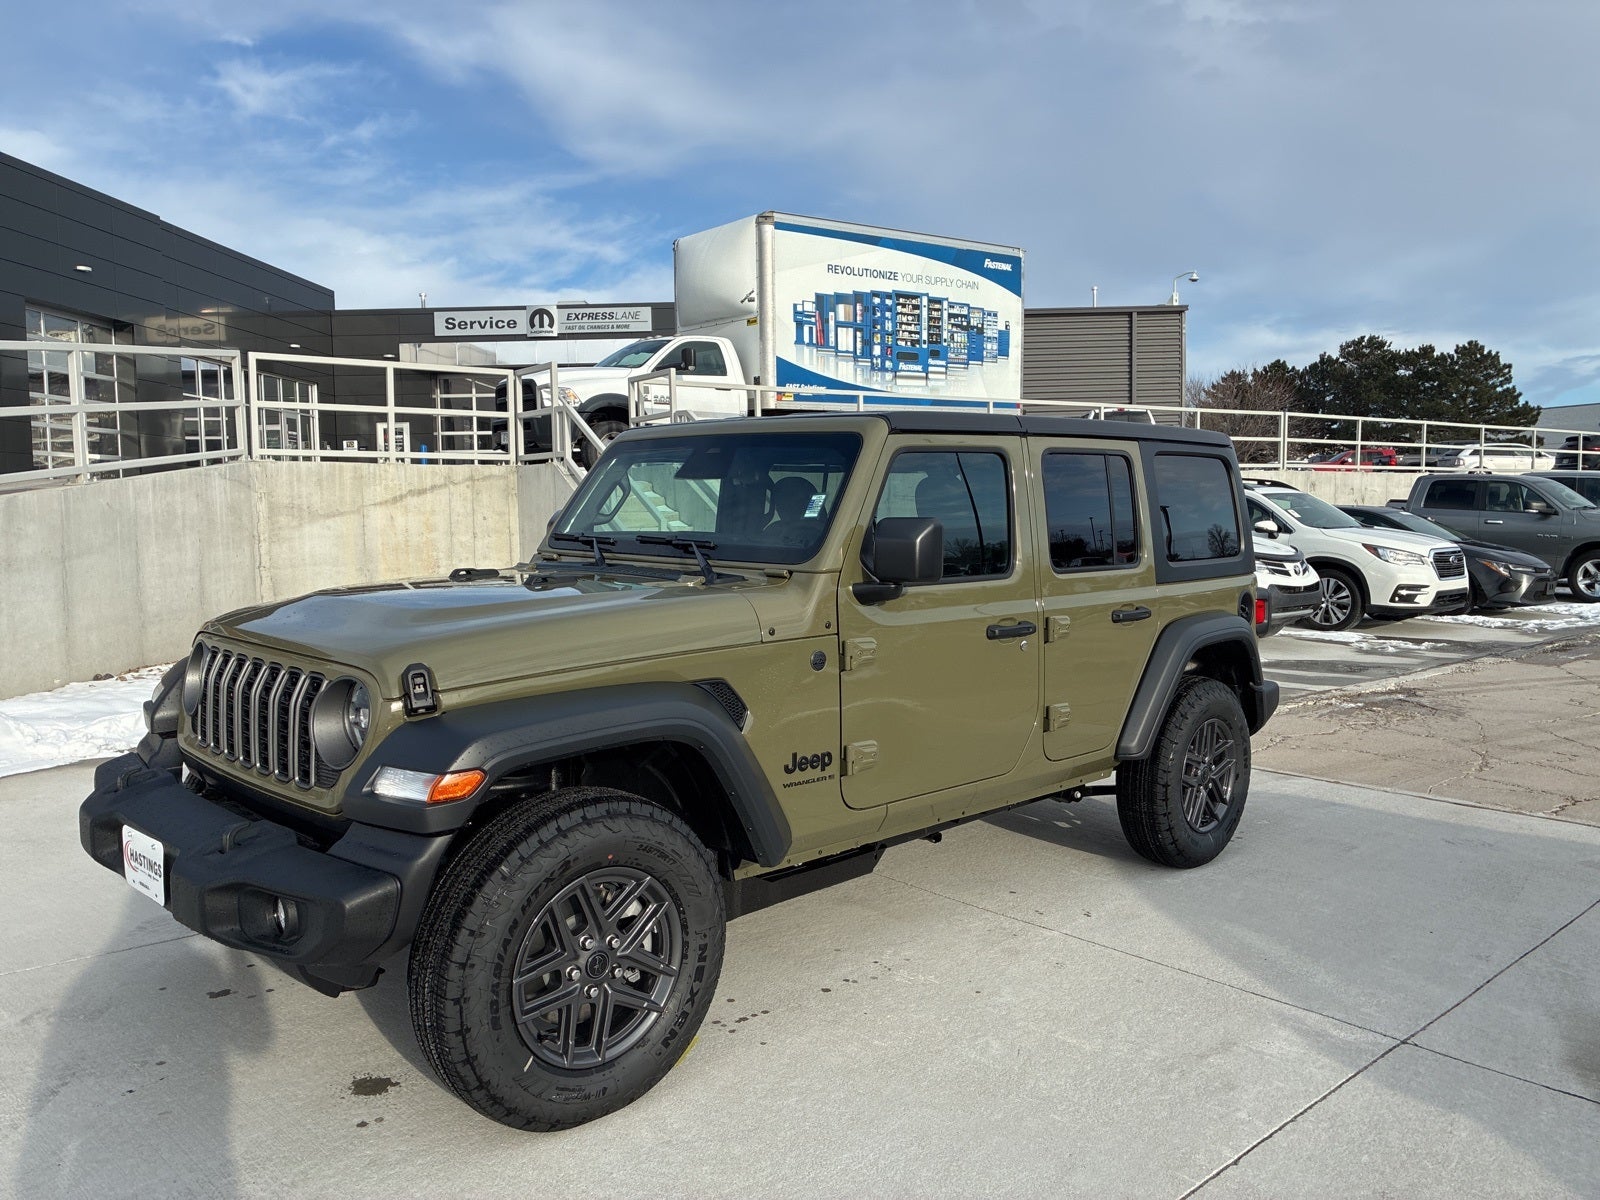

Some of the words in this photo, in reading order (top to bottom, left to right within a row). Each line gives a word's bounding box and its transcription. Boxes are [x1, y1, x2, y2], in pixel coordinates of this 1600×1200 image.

[983, 258, 1012, 271] FASTENAL
[827, 263, 899, 281] REVOLUTIONIZE
[900, 272, 924, 284] YOUR
[925, 274, 954, 288] SUPPLY
[955, 278, 980, 291] CHAIN
[444, 317, 518, 330] Service
[783, 751, 833, 775] Jeep
[782, 775, 828, 789] WRANGLER
[129, 847, 162, 879] HASTINGS
[660, 942, 709, 1050] NEXEN
